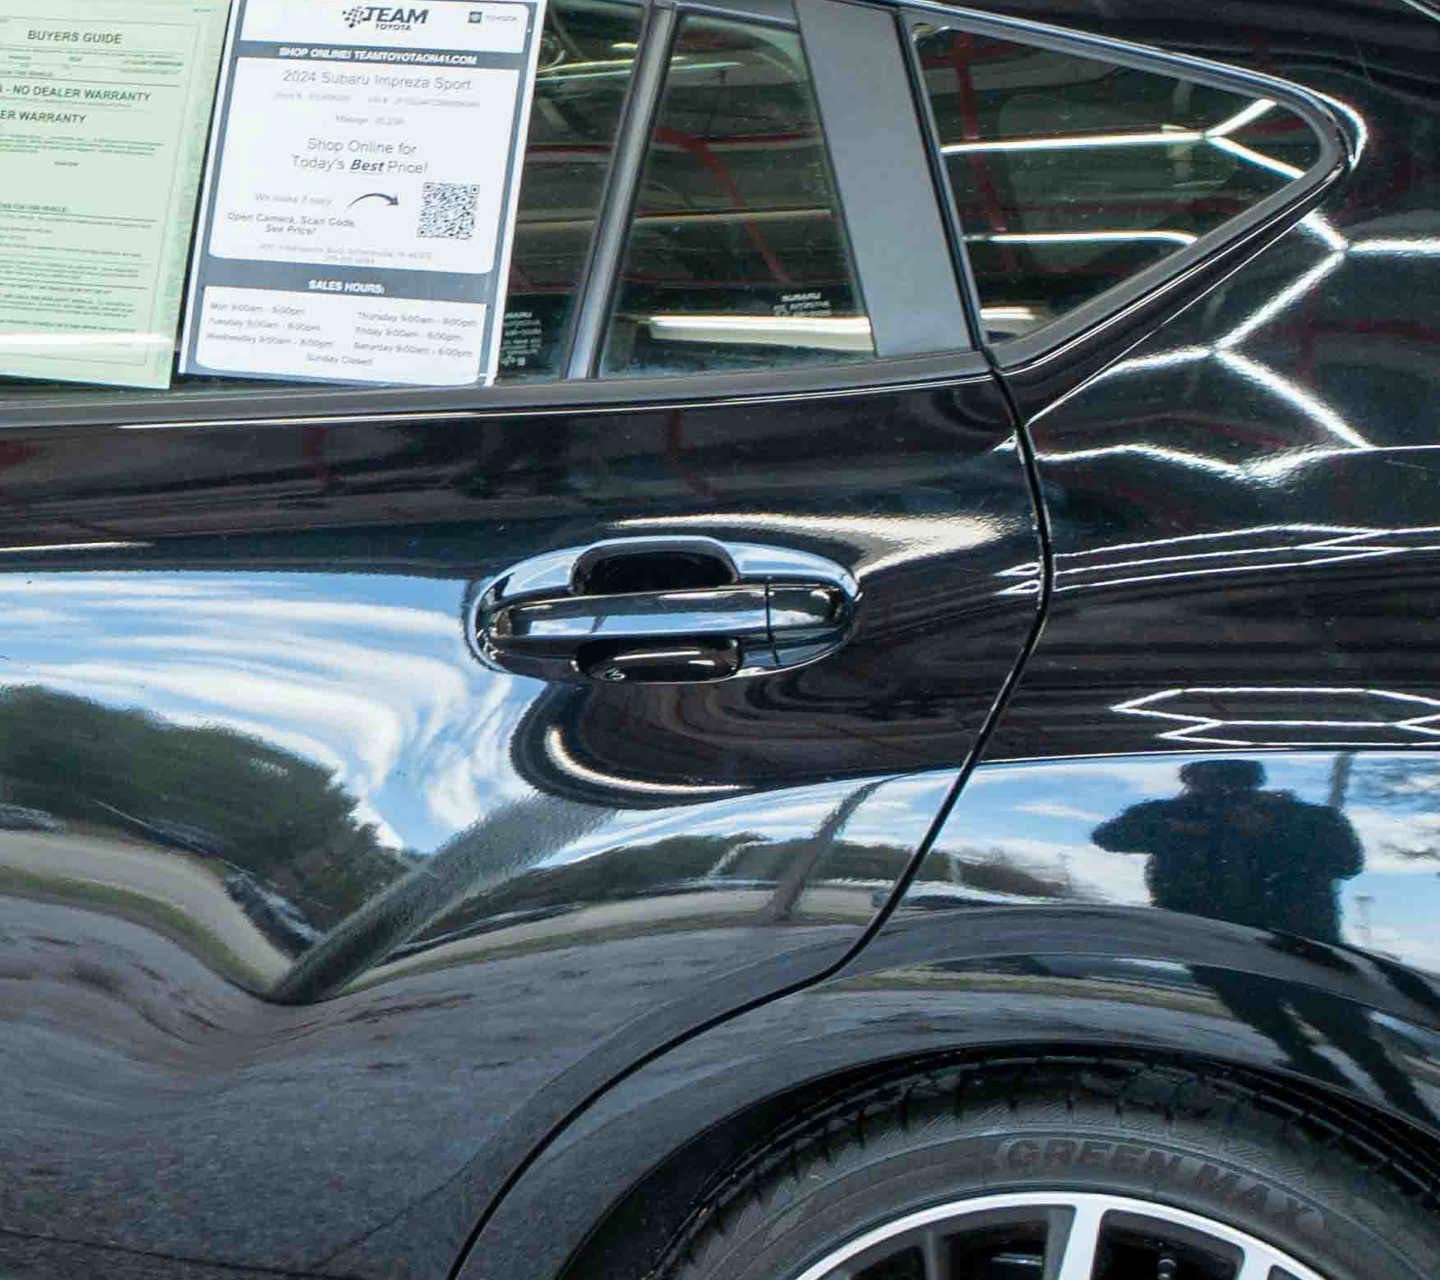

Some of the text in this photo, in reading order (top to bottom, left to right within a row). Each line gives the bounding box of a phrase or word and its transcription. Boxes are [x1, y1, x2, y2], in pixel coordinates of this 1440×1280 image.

[367, 6, 429, 25] TEAM
[375, 23, 411, 31] TOYOTA
[27, 29, 123, 45] BUYERS GUIDE
[278, 47, 309, 58] SHOP
[282, 69, 472, 91] 2024 Subaru Impreza Sport
[13, 85, 30, 96] NO
[33, 86, 81, 99] DEALER
[84, 89, 152, 102] WARRANTY
[19, 111, 87, 124] WARRANTY
[307, 138, 417, 155] Shop Online for
[291, 155, 428, 174] Today's Best Price!
[308, 279, 343, 292] SALES
